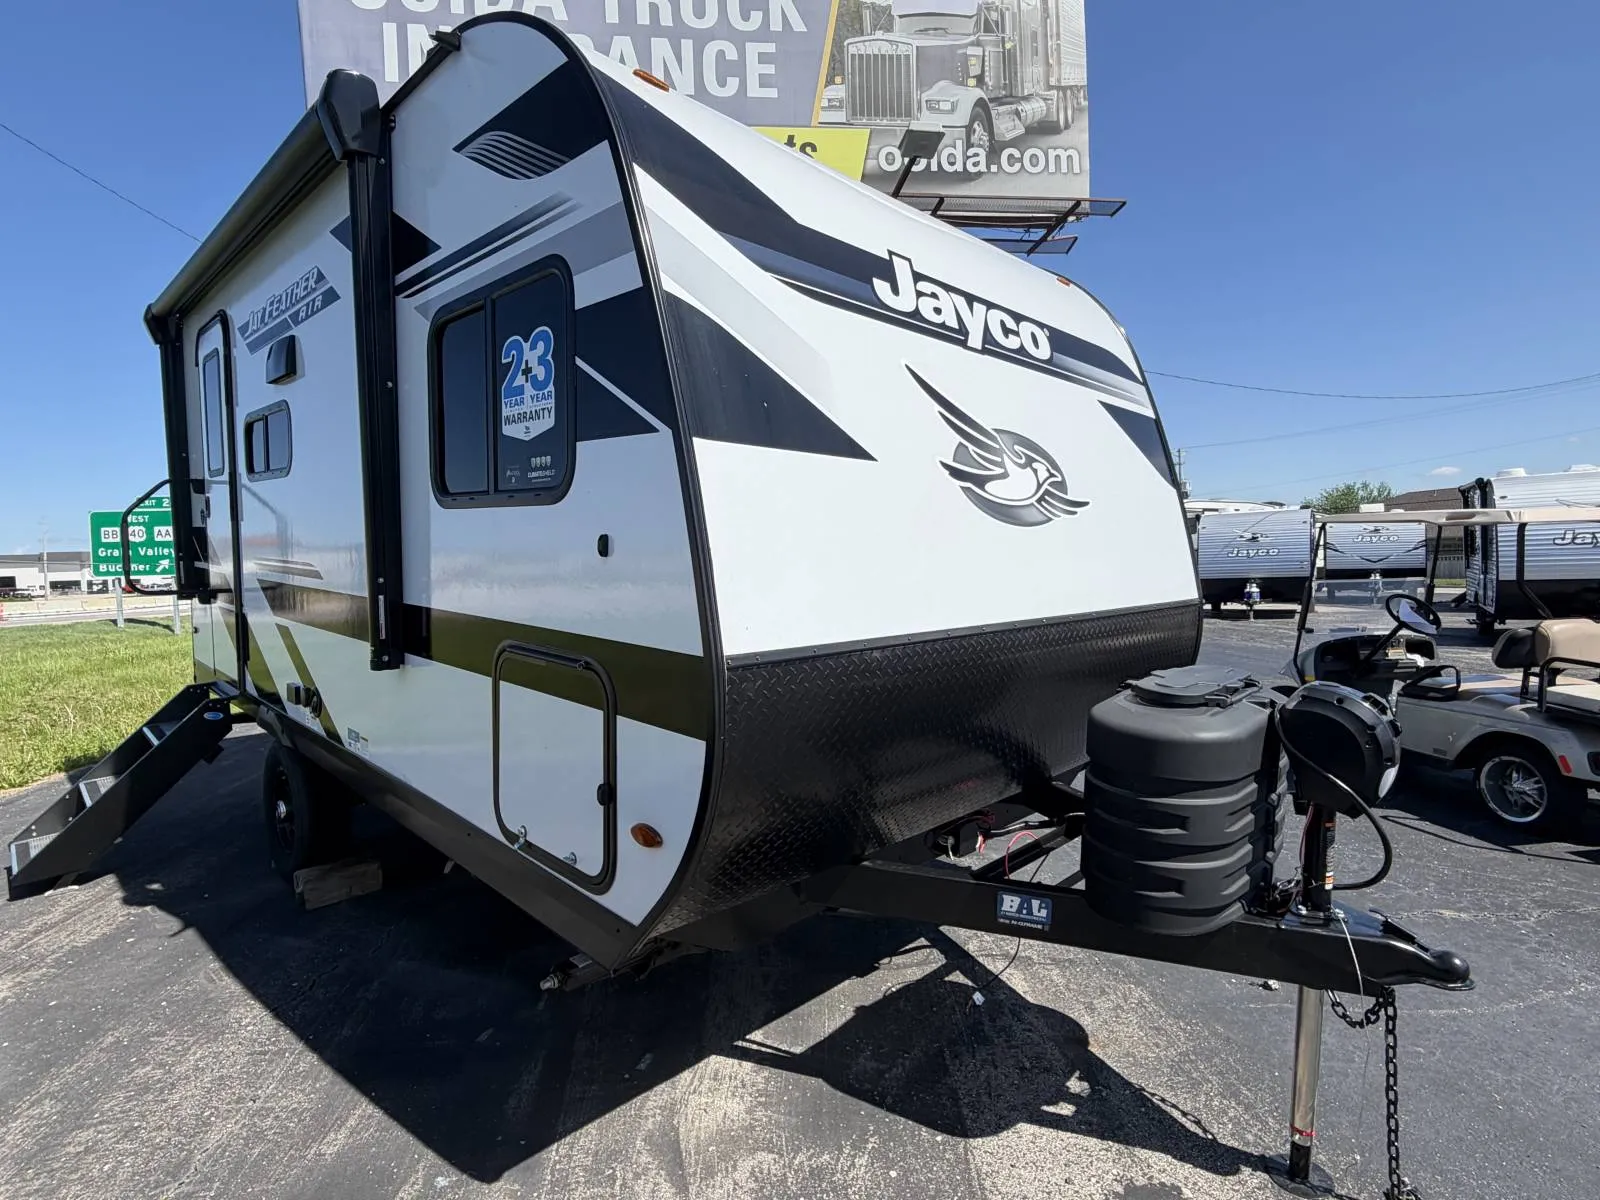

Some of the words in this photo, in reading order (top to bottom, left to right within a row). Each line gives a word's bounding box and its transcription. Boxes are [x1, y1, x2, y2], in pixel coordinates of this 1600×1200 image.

[382, 22, 778, 99] INANCE
[264, 266, 318, 324] FEATHER
[872, 251, 1052, 361] Jayco
[503, 397, 525, 410] YEAR
[529, 390, 553, 404] YEAR
[503, 406, 553, 427] WARRANTY
[103, 529, 119, 540] BB
[129, 529, 145, 539] 40
[156, 528, 172, 539] AA
[1352, 534, 1400, 543] Jayco
[98, 547, 132, 557] Gra
[138, 546, 175, 558] Valley
[1227, 547, 1280, 559] Jayco
[99, 563, 151, 572] Bucner
